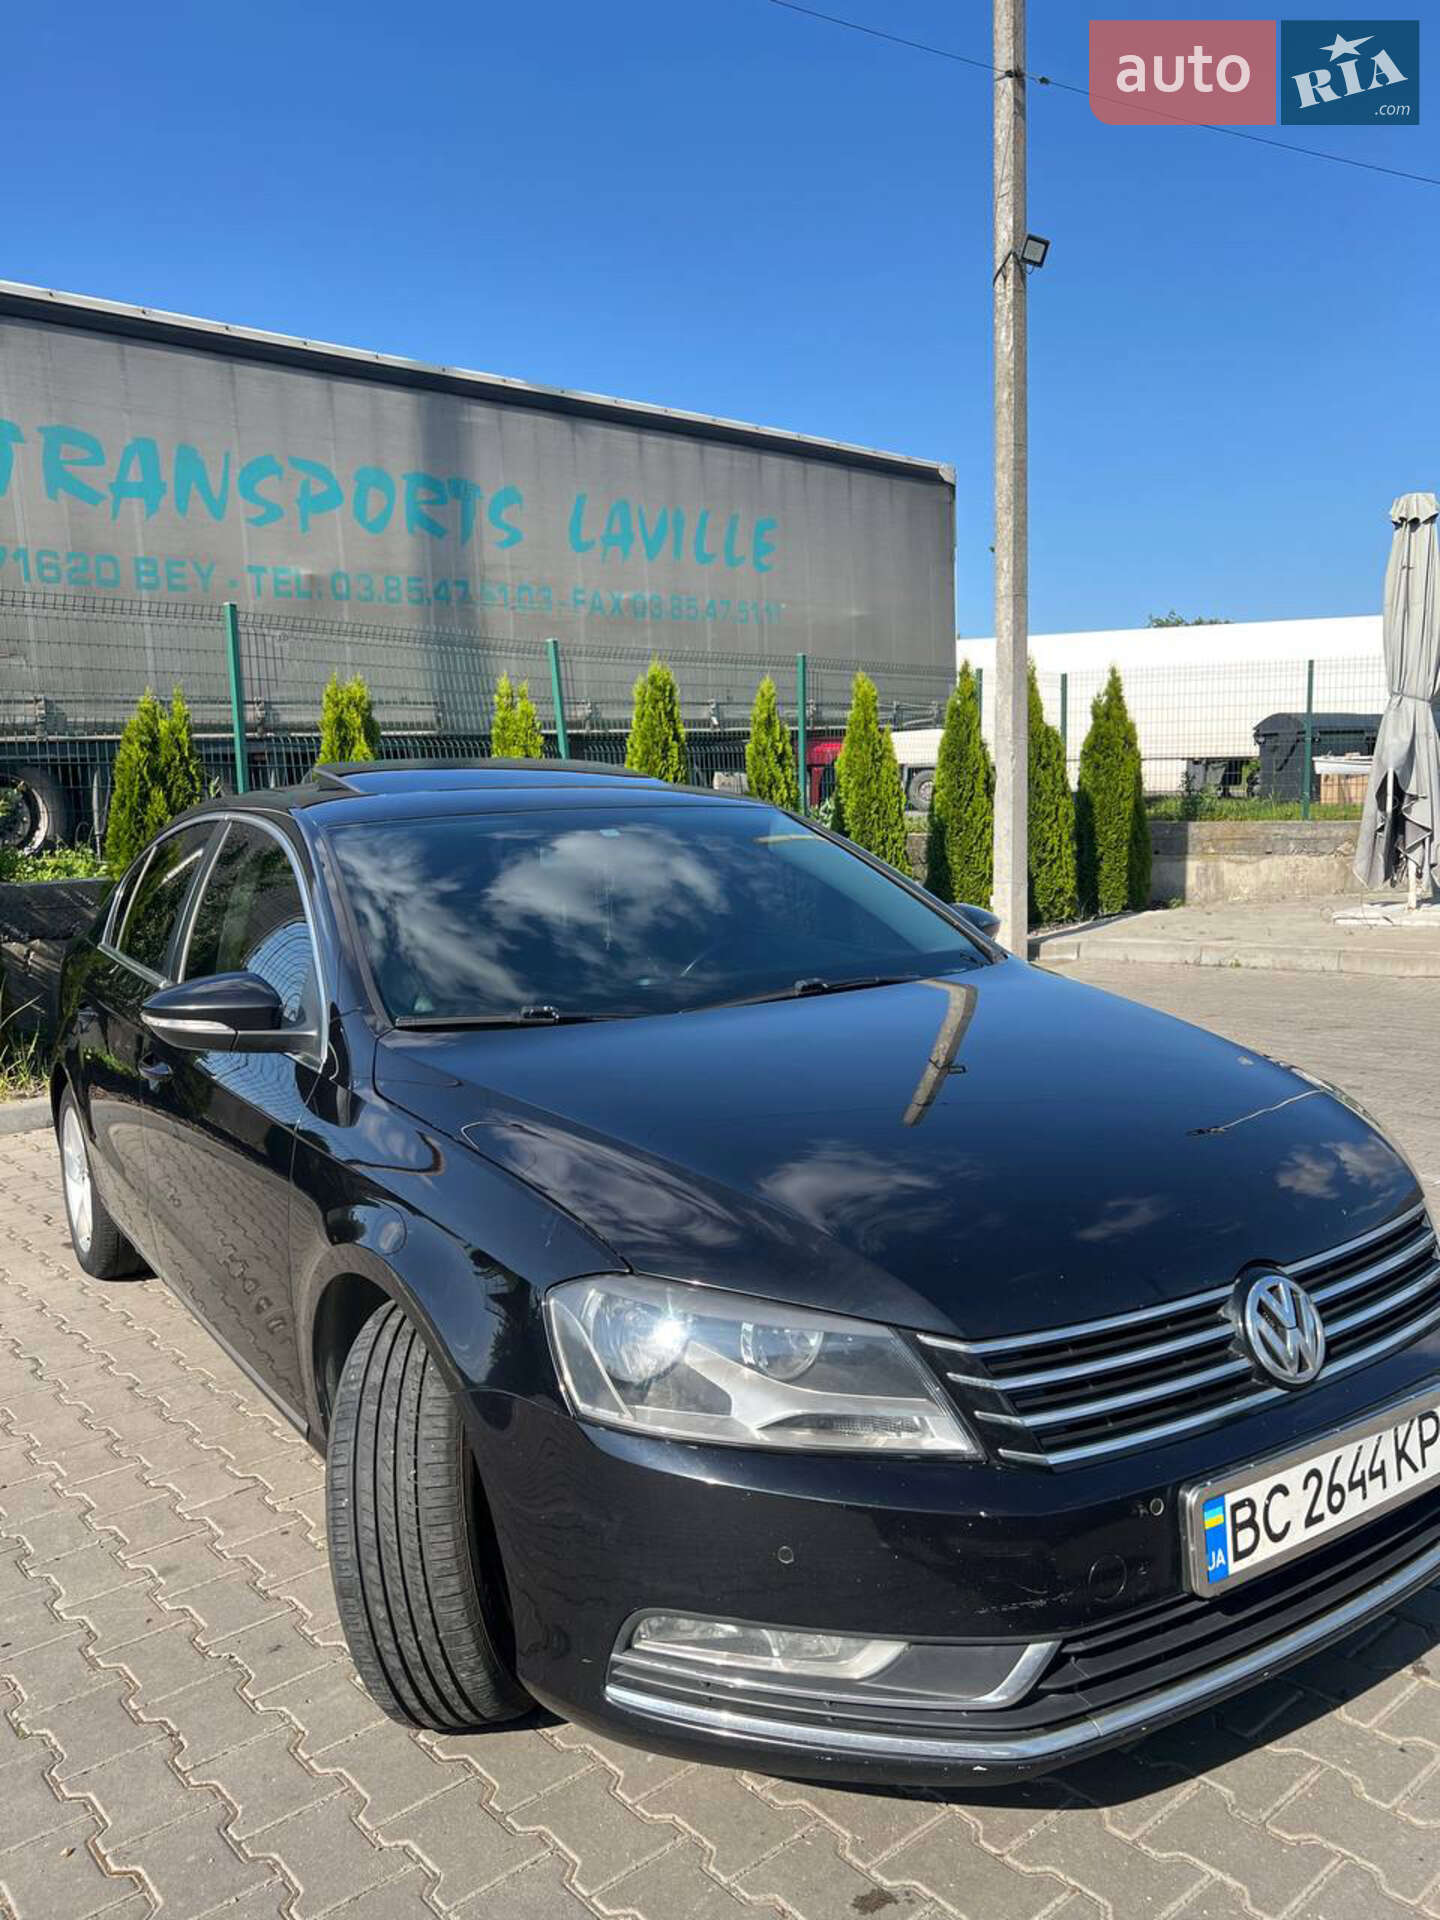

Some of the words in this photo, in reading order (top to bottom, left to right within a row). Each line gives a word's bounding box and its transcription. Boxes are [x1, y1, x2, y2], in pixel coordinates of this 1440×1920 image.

[568, 492, 779, 574] LAVILLE
[0, 545, 121, 589] 1620
[133, 552, 217, 593] BEY
[571, 583, 625, 617] FAX
[1230, 1483, 1291, 1563] BC
[1302, 1435, 1387, 1529] 2644
[1393, 1410, 1440, 1482] KP
